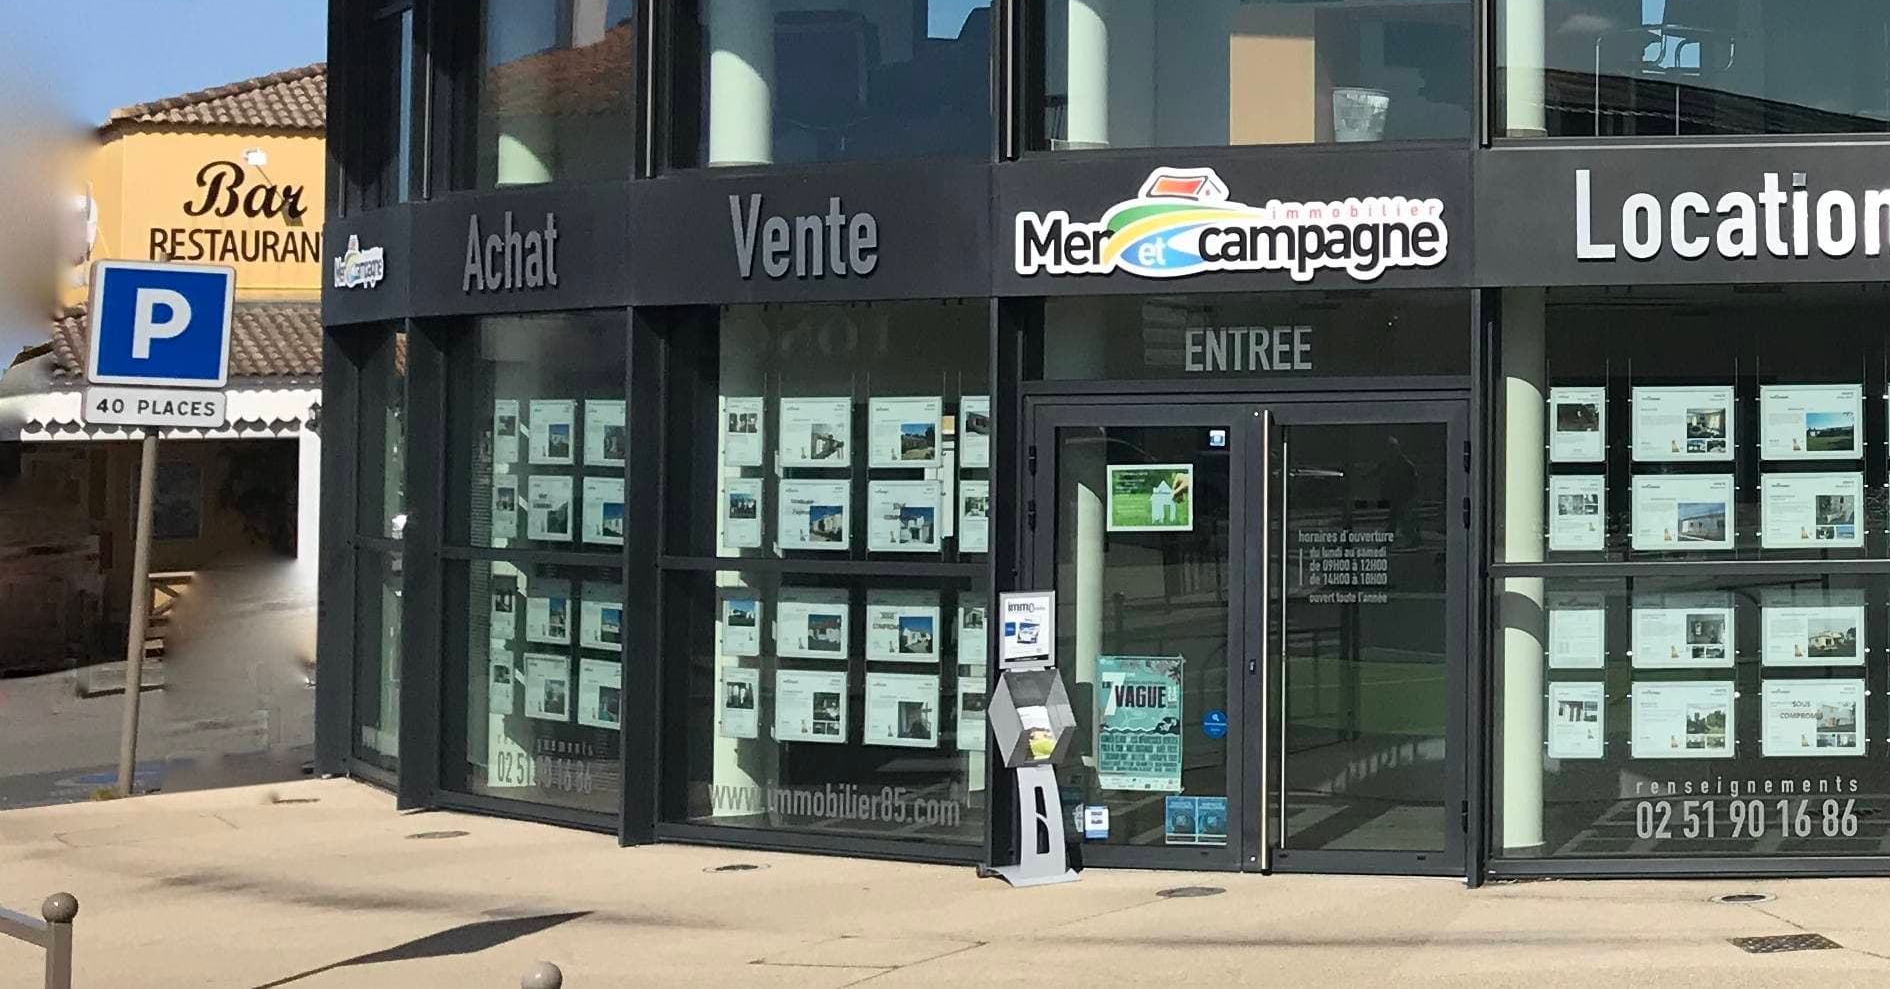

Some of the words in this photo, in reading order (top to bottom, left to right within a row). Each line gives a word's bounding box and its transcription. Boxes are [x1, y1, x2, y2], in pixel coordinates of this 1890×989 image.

[184, 161, 307, 218] Bar
[1272, 204, 1436, 220] immobilier
[150, 228, 323, 262] RESTAURAN
[462, 211, 559, 292] Achat
[729, 193, 878, 278] Vente
[1023, 219, 1112, 266] Mer
[1138, 238, 1168, 266] et
[1200, 221, 1440, 272] campagne
[132, 288, 192, 359] P
[1185, 325, 1312, 371] ENTREE
[96, 398, 124, 414] 40
[138, 399, 215, 416] PLACES
[1298, 530, 1338, 542] horaires
[1340, 530, 1394, 542] d'ouverture
[1322, 559, 1350, 571] 09H00
[1360, 559, 1388, 571] 12H00
[1323, 573, 1350, 585] 14H00
[1114, 685, 1167, 708] VAGUE
[497, 751, 512, 783] 02
[708, 778, 960, 827] www.immobilier85.com
[1636, 776, 1858, 797] renseignements
[1636, 800, 1672, 838] 02
[1683, 800, 1714, 838] 51
[1729, 800, 1765, 838] 90
[1777, 799, 1811, 837] 16
[1822, 798, 1858, 837] 86
